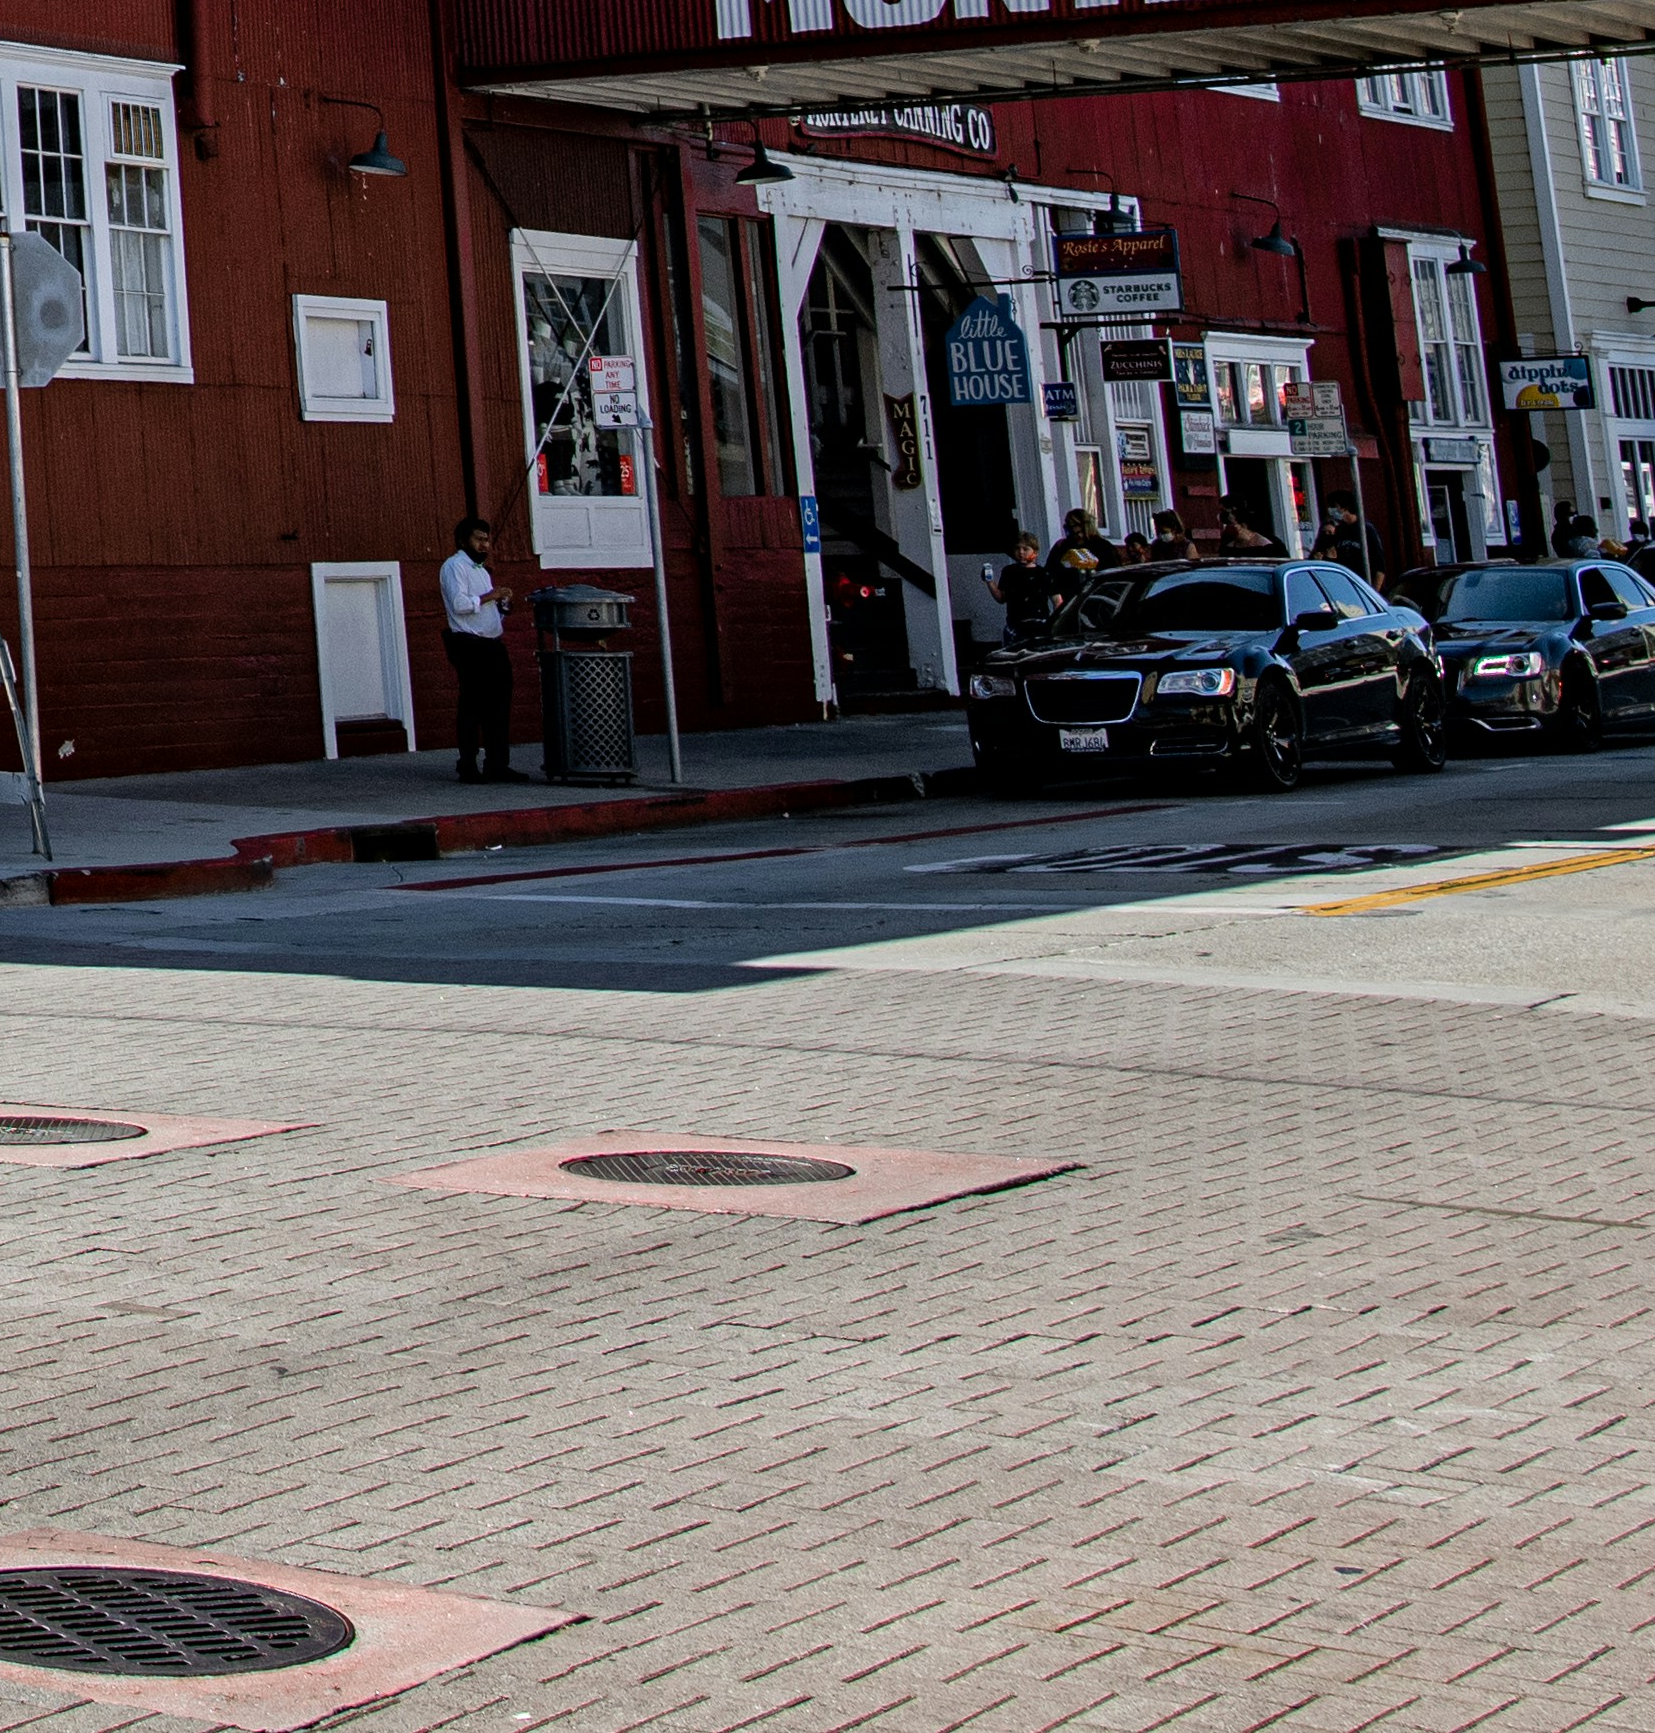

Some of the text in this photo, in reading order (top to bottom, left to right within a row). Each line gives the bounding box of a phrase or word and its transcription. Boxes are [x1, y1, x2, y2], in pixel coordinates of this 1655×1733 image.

[967, 108, 990, 150] CO
[1063, 234, 1166, 256] Rosie's Apparel
[1103, 282, 1171, 295] STARBUCKS
[1116, 293, 1160, 303] COFFEE
[958, 310, 1008, 339] little
[950, 339, 1021, 373] BLUE
[603, 360, 630, 368] PARKING
[605, 371, 619, 379] ANY
[605, 380, 620, 389] TIME
[953, 373, 1025, 401] HOUSE
[1286, 385, 1298, 394] NO
[1538, 380, 1579, 394] dots
[610, 394, 619, 404] NO
[1046, 389, 1075, 400] ATM
[599, 404, 631, 414] LOADING
[920, 395, 933, 460] 711
[1294, 421, 1302, 434] 2
[1309, 431, 1342, 439] PARKING
[893, 403, 917, 485] MAGIC
